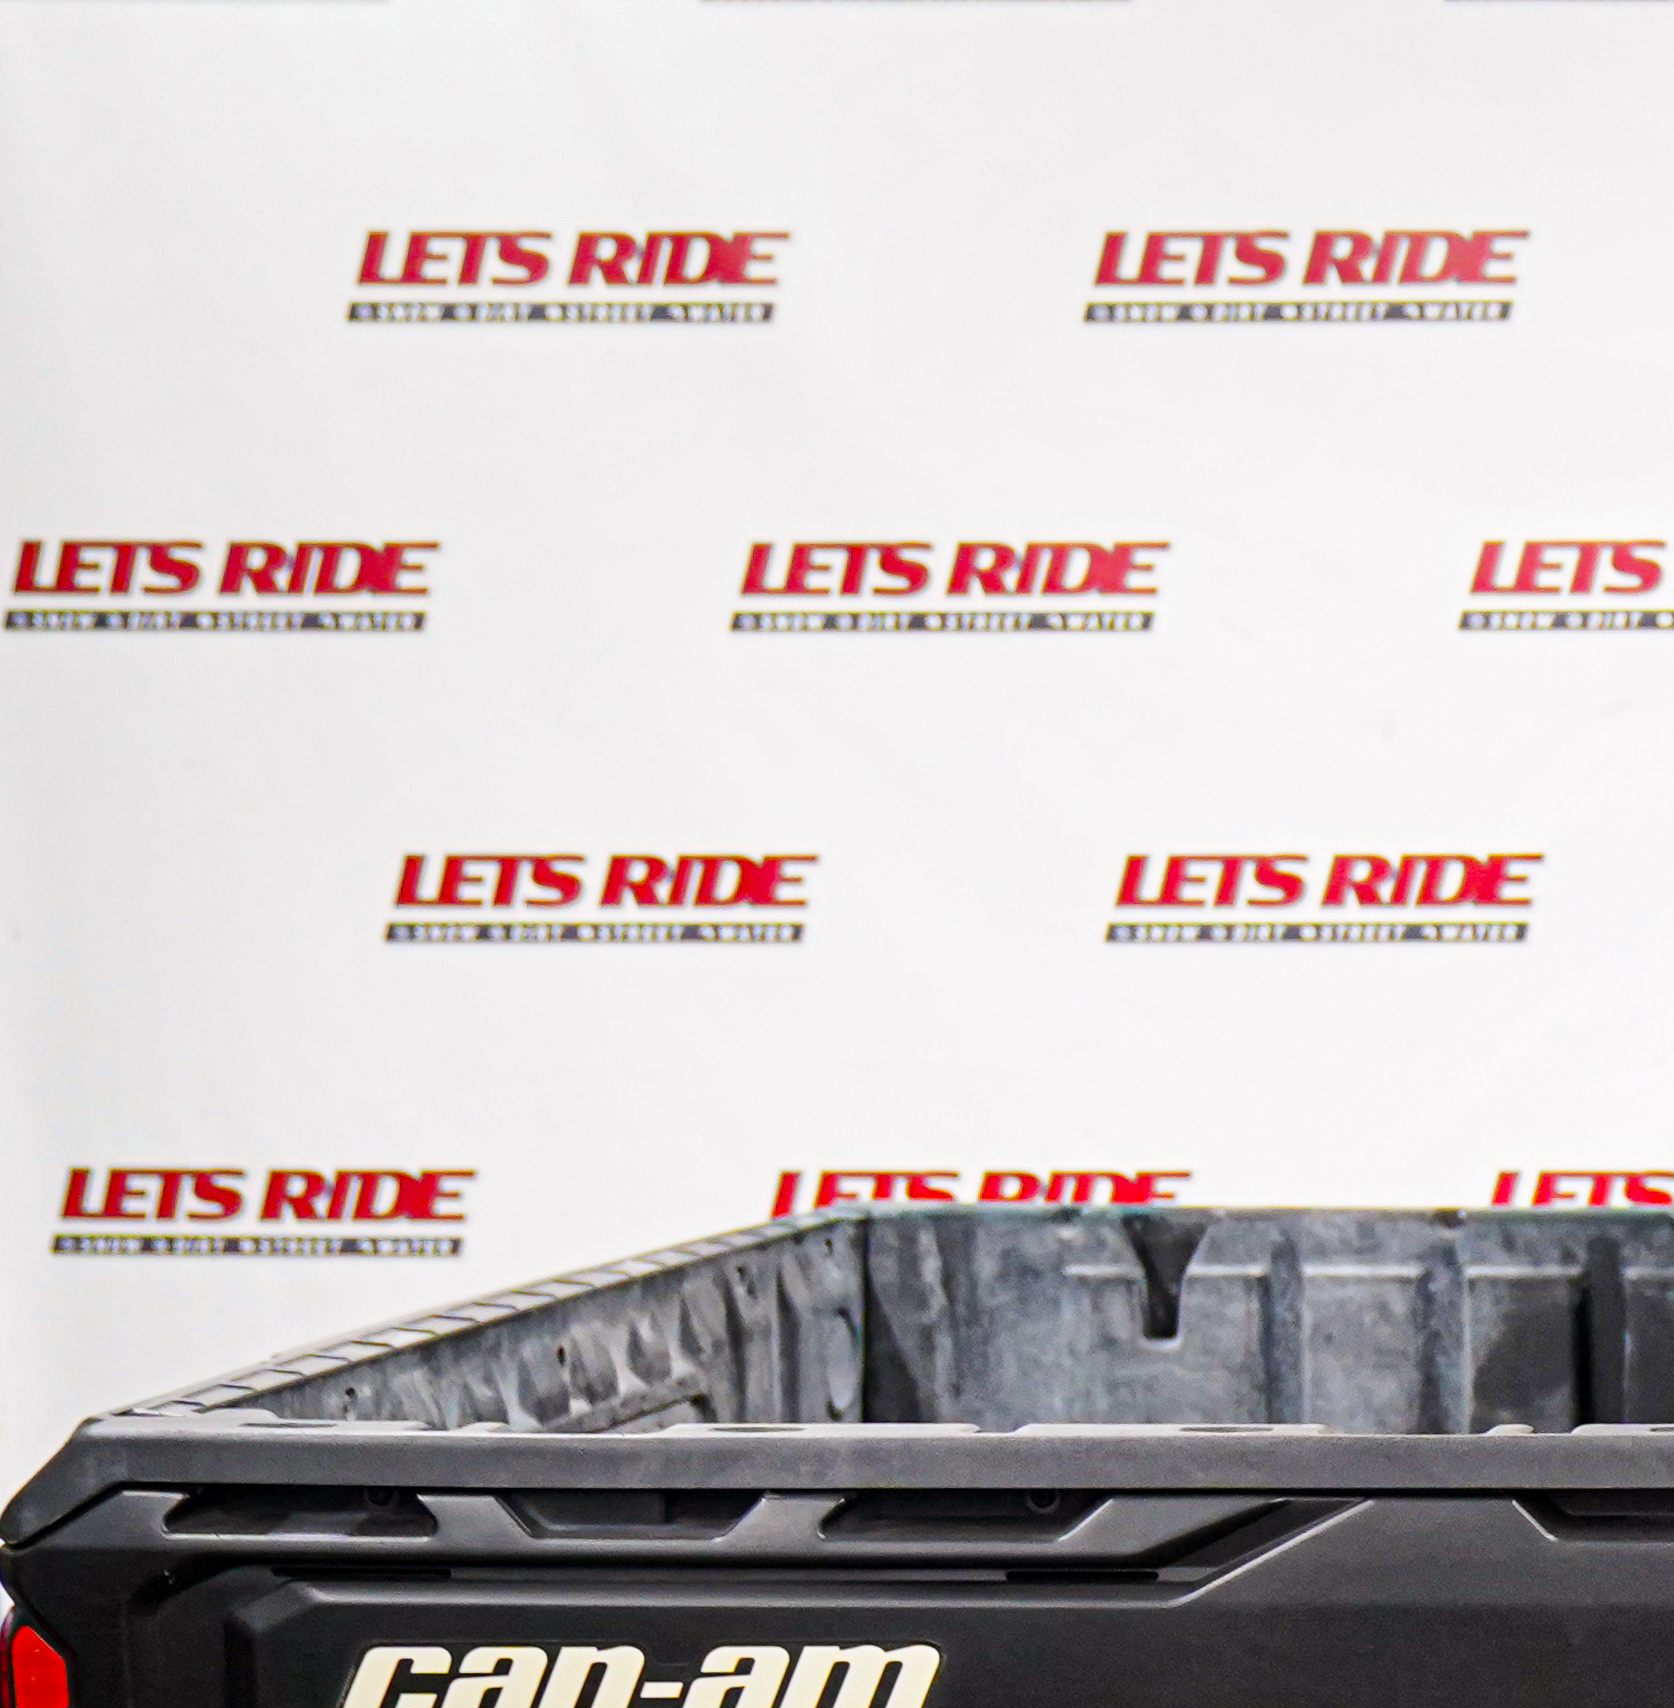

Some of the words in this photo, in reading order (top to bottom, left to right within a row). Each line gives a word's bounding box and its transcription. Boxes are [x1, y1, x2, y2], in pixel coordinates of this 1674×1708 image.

[357, 230, 553, 286] LETS
[567, 230, 790, 286] RIDE
[1093, 229, 1289, 286] LETS
[1303, 229, 1526, 286] RIDE
[13, 540, 202, 596] LETS
[217, 541, 441, 596] RIDE
[738, 540, 934, 596] LETS
[947, 540, 1171, 596] RIDE
[1470, 540, 1667, 596] LETS
[393, 853, 587, 908] LETS
[598, 853, 820, 908] RIDE
[1115, 853, 1311, 908] LETS
[1322, 853, 1544, 907] RIDE
[61, 1168, 248, 1222] LETS
[261, 1169, 477, 1223] RIDE
